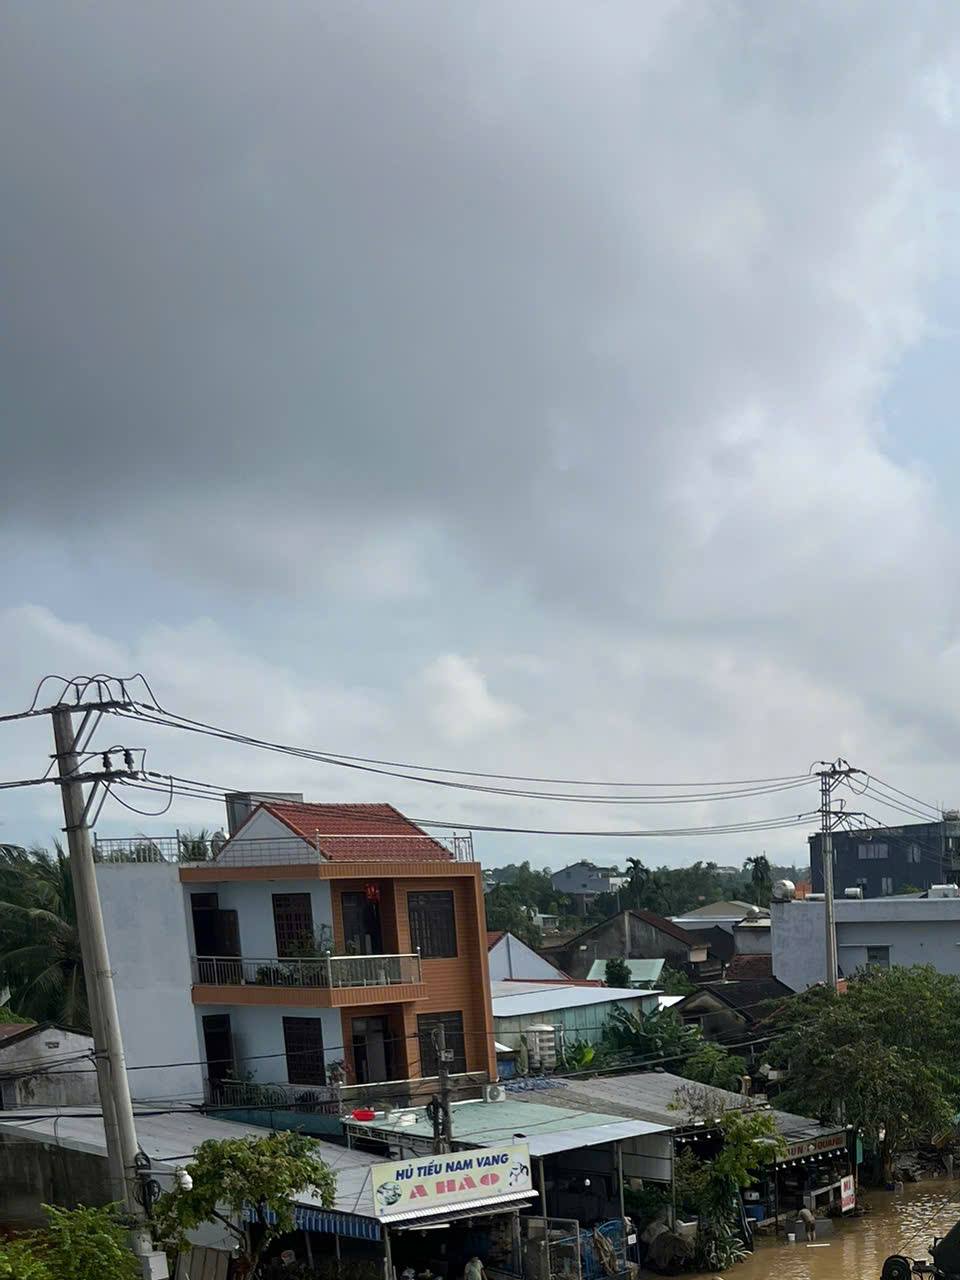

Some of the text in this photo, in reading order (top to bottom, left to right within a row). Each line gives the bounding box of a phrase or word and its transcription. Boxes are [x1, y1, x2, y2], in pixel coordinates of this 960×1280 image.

[395, 1164, 414, 1180] HỦ
[445, 1159, 473, 1173] NAM
[477, 1153, 509, 1168] VANG
[409, 1184, 428, 1199] A
